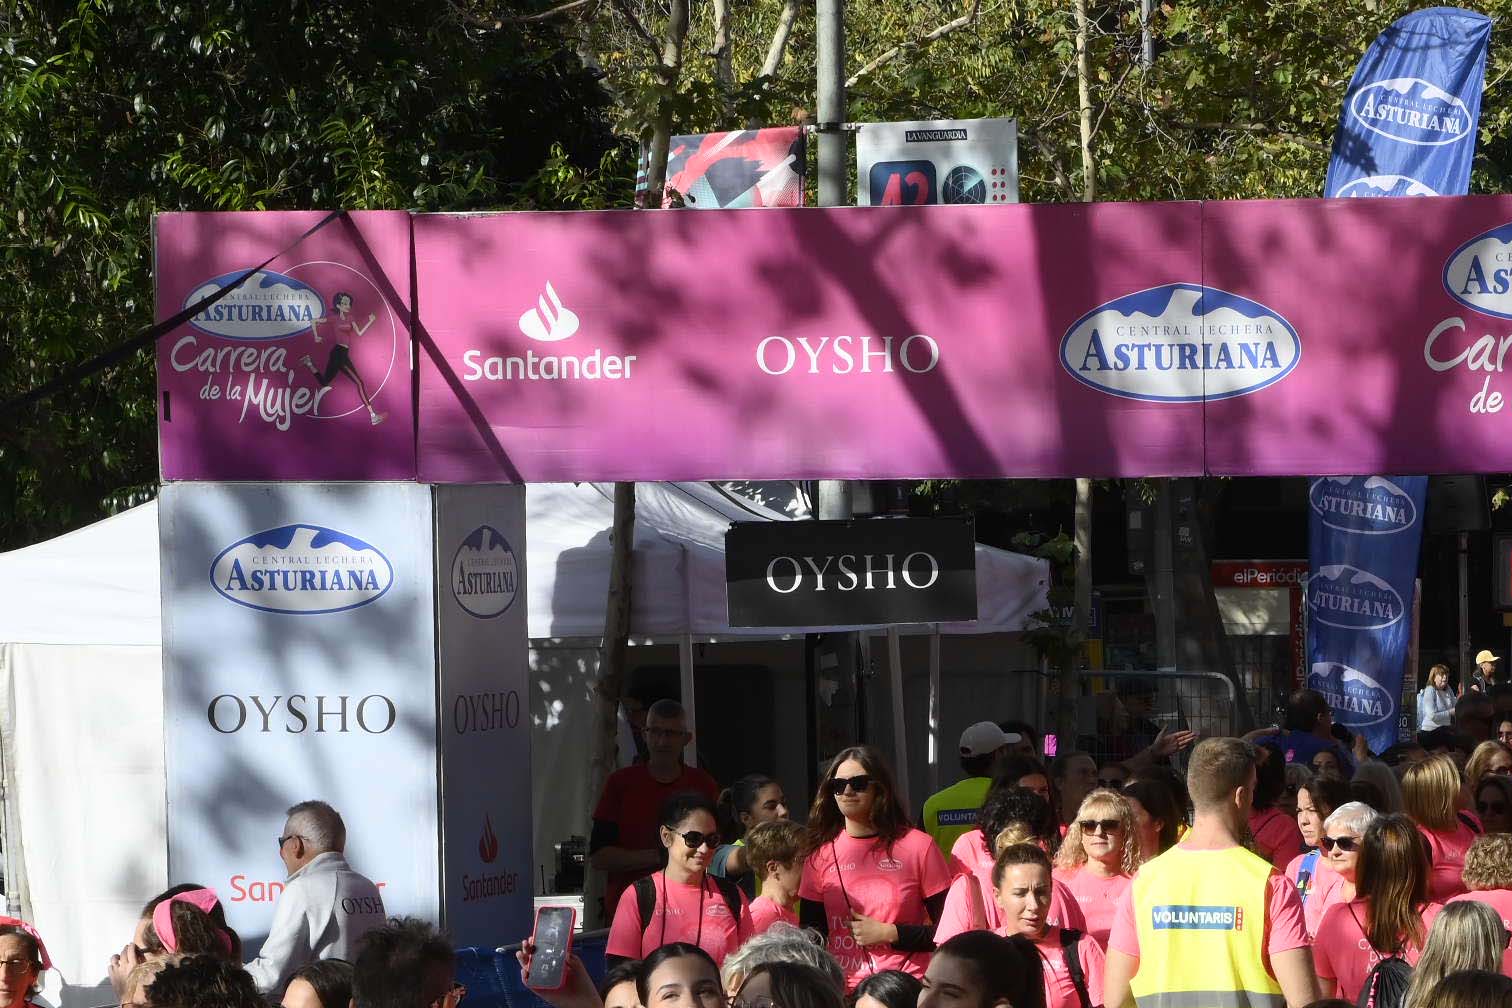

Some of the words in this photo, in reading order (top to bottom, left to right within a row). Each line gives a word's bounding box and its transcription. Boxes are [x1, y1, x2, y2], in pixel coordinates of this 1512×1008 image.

[1361, 93, 1460, 134] ASTURIANA
[1116, 326, 1190, 336] CENTRAL
[1199, 324, 1273, 336] LECHERA
[170, 336, 287, 373] Carrera
[464, 350, 637, 380] Santander
[756, 334, 939, 375] OYSHO
[1079, 329, 1281, 371] ASTURIANA
[200, 379, 221, 400] de
[227, 375, 242, 400] la
[239, 370, 332, 432] Mujer
[1470, 375, 1503, 414] de
[225, 558, 380, 592] ASTURIANA
[252, 556, 310, 565] CENTRAL
[766, 552, 939, 593] OYSHO
[457, 569, 514, 595] ASTURIANA
[208, 694, 396, 734] OYSHO
[454, 690, 520, 735] OYSHO
[938, 812, 978, 823] VOLUNTA
[463, 870, 519, 902] Santander
[342, 897, 384, 915] OYSH
[1153, 911, 1233, 926] VOLUNTARIS
